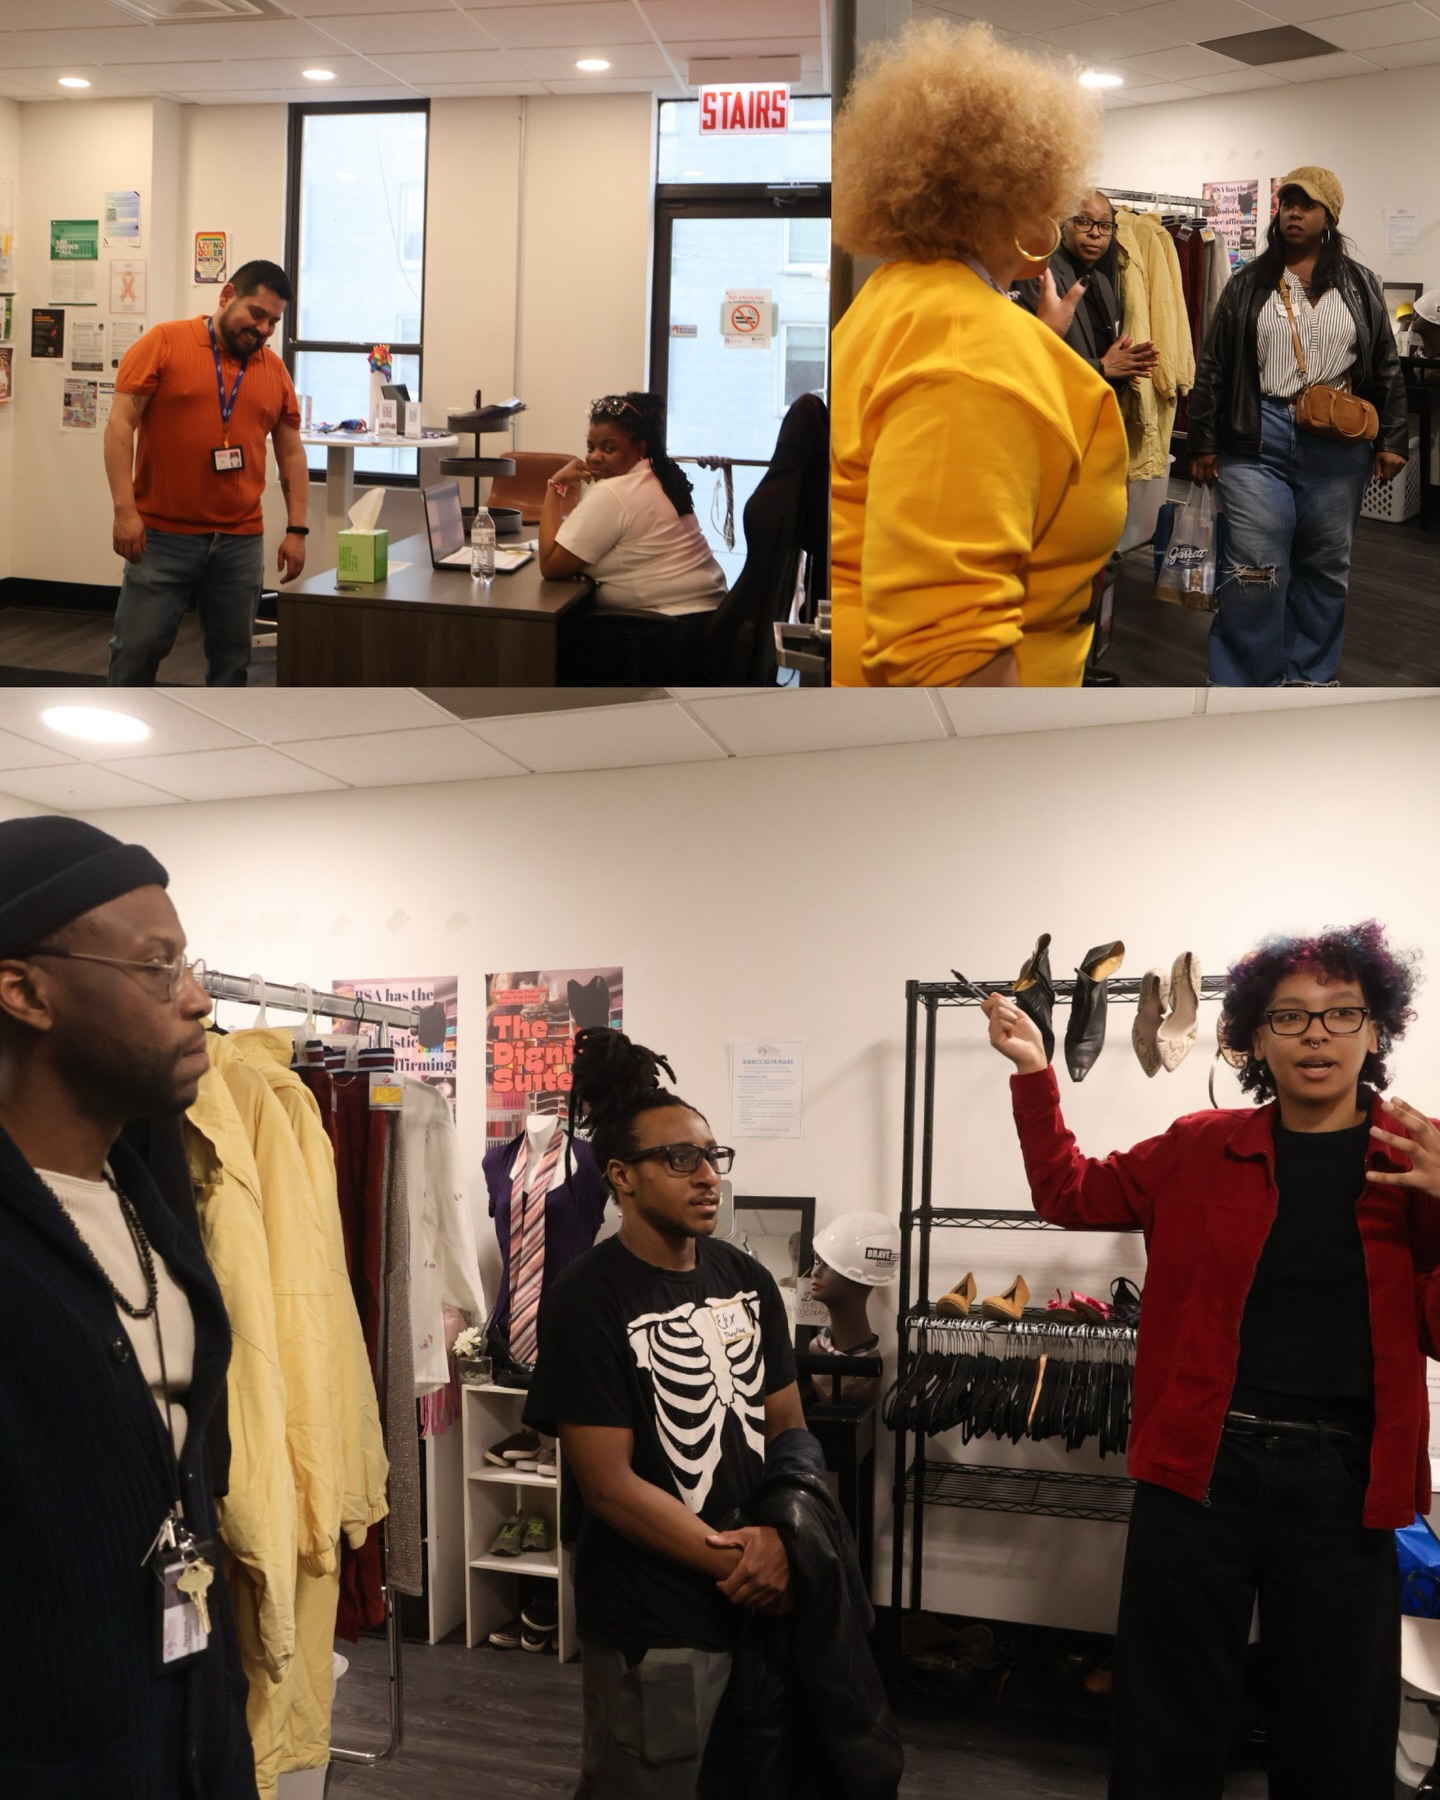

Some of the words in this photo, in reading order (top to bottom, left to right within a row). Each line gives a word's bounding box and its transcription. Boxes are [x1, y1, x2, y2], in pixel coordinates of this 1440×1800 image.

[703, 90, 785, 129] STAIRS
[198, 241, 225, 249] LIVING
[198, 249, 224, 257] QUEER
[1169, 546, 1209, 566] Garrett
[385, 988, 409, 1002] has
[411, 987, 434, 1001] the
[493, 1015, 548, 1039] The
[394, 1057, 453, 1075] ffirming
[492, 1068, 574, 1093] Suite
[867, 1249, 891, 1260] BRAVE
